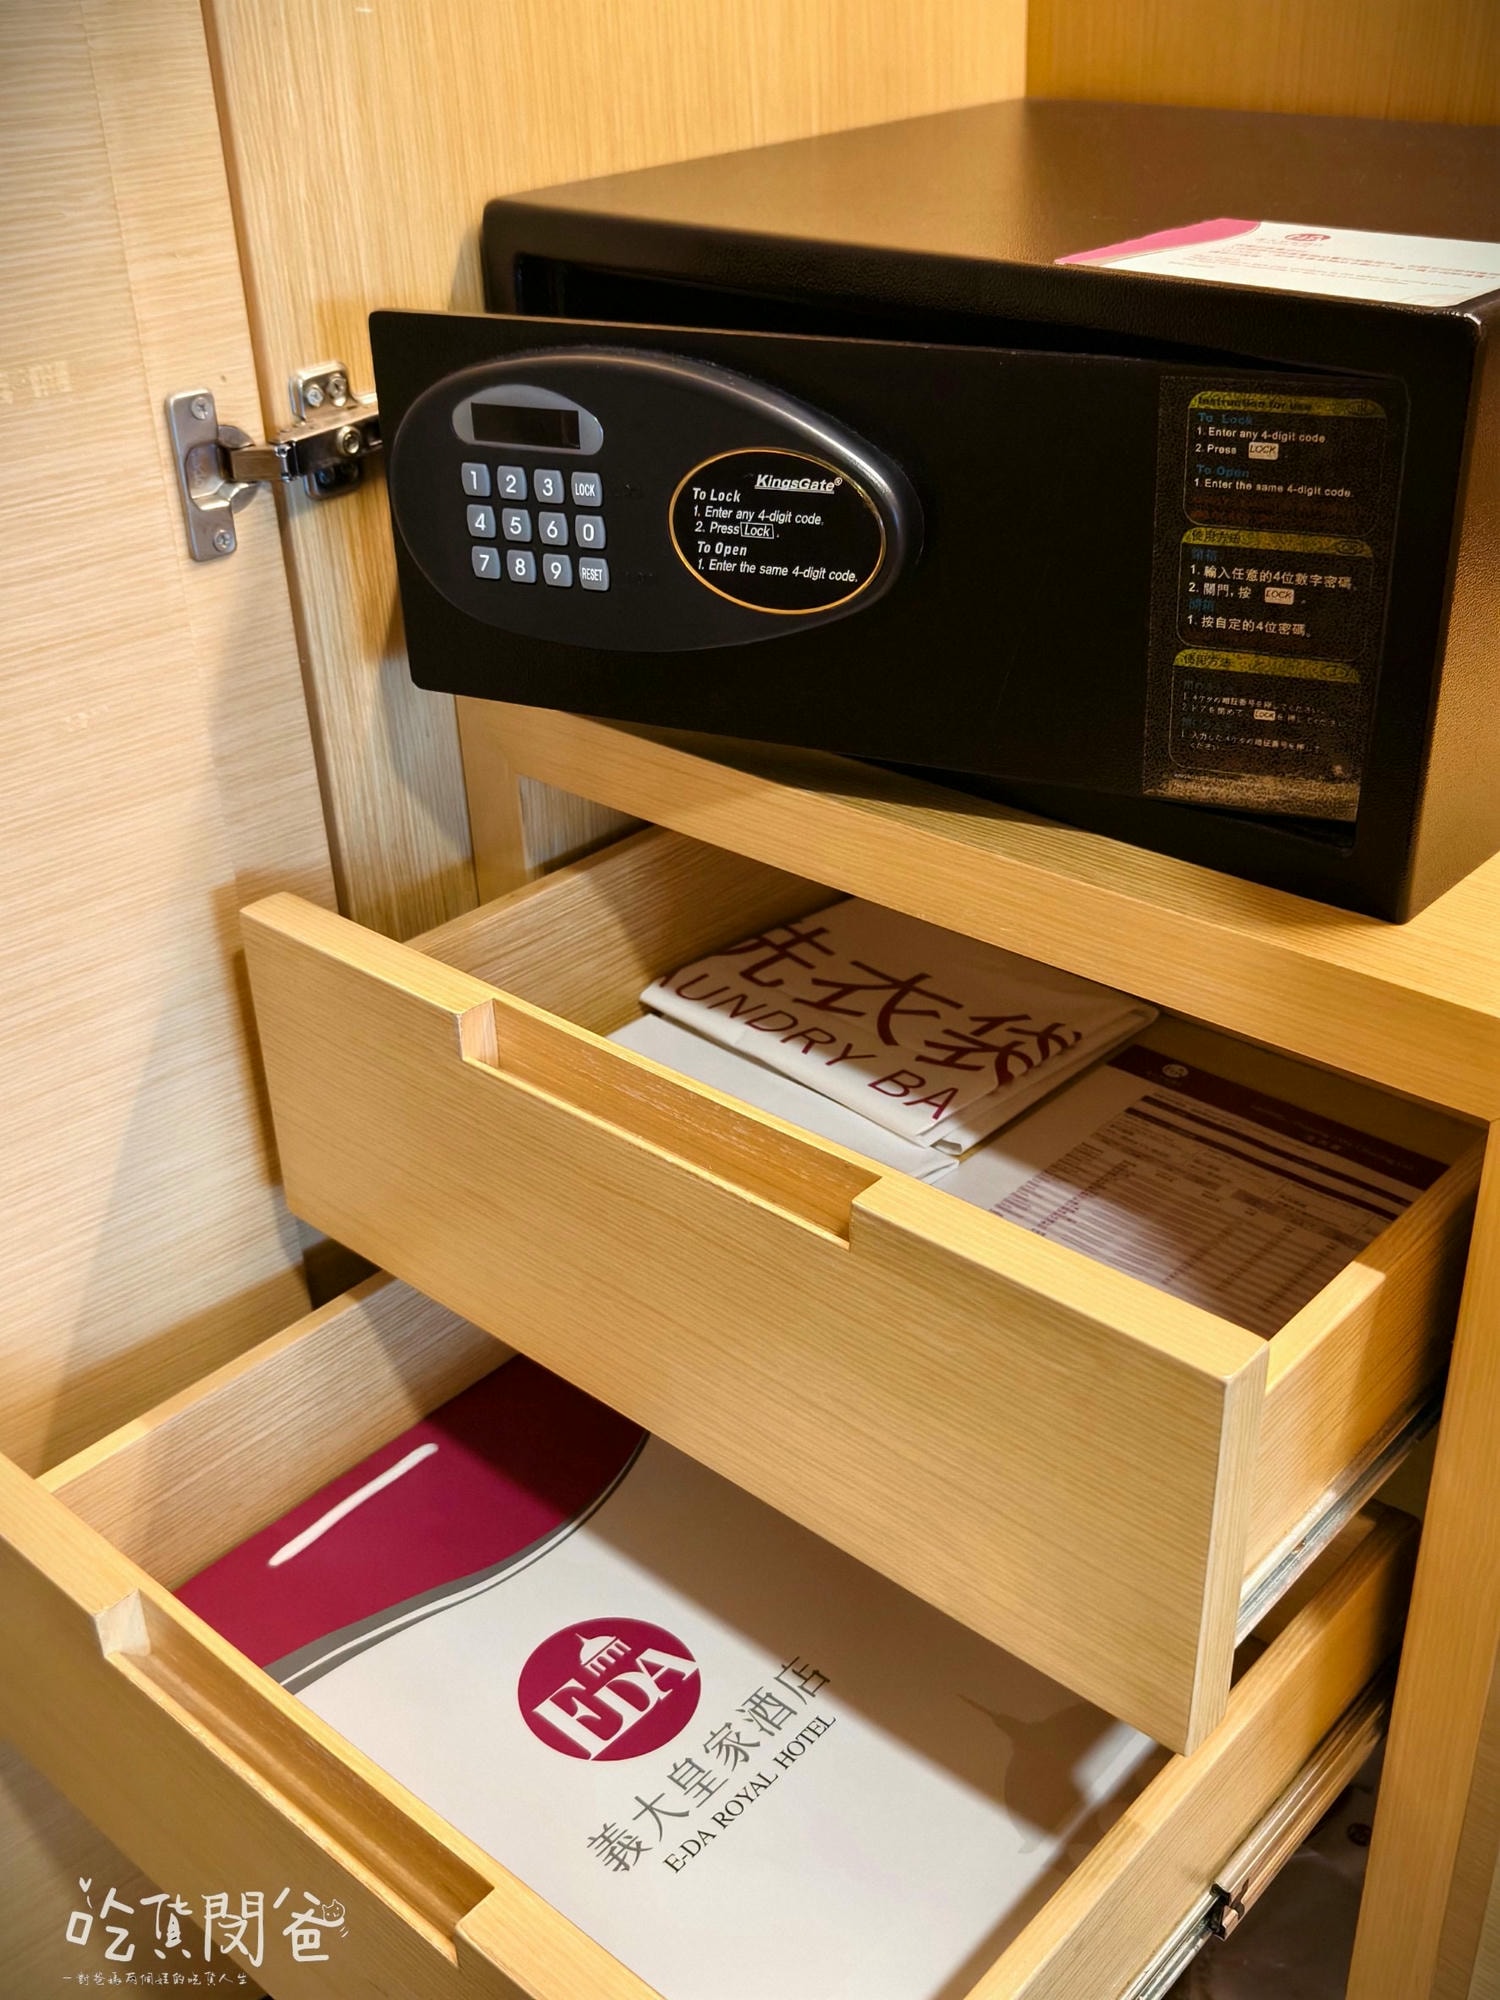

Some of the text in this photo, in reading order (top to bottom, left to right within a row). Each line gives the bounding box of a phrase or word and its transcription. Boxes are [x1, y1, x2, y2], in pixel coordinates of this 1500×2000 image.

[1208, 427, 1237, 438] Enter
[1239, 430, 1258, 441] any
[1261, 431, 1296, 444] 4-digit
[1207, 444, 1237, 454] Press
[1249, 444, 1276, 455] LOCK
[471, 471, 478, 490] 1
[505, 475, 516, 493] 2
[542, 478, 553, 496] 3
[1204, 479, 1232, 489] Enter
[1235, 481, 1252, 491] the
[1256, 484, 1284, 493] same
[1287, 484, 1321, 496] 4-digit
[575, 483, 595, 497] LOCK
[692, 488, 741, 503] To Lock
[475, 513, 486, 531] 4
[694, 506, 701, 517] 1.
[705, 505, 733, 519] Enter
[736, 509, 754, 521] any
[758, 509, 792, 525] 4-digit
[510, 517, 522, 534] 5
[547, 521, 558, 538] 6
[583, 524, 595, 541] 0
[694, 521, 770, 538] 2. Press Lock
[697, 541, 747, 557] To Open
[479, 554, 490, 572] 7
[515, 558, 526, 576] 8
[551, 562, 562, 579] 9
[698, 559, 858, 582] 1. Enter the same 4-digit code.
[582, 567, 603, 581] RESET
[1265, 588, 1293, 601] LOCK
[659, 969, 877, 1067] UNDRY
[532, 1648, 698, 1761] EDA
[586, 1655, 831, 1873] 義大皇家酒店
[662, 1714, 837, 1874] E-DA ROYAL HOTEL
